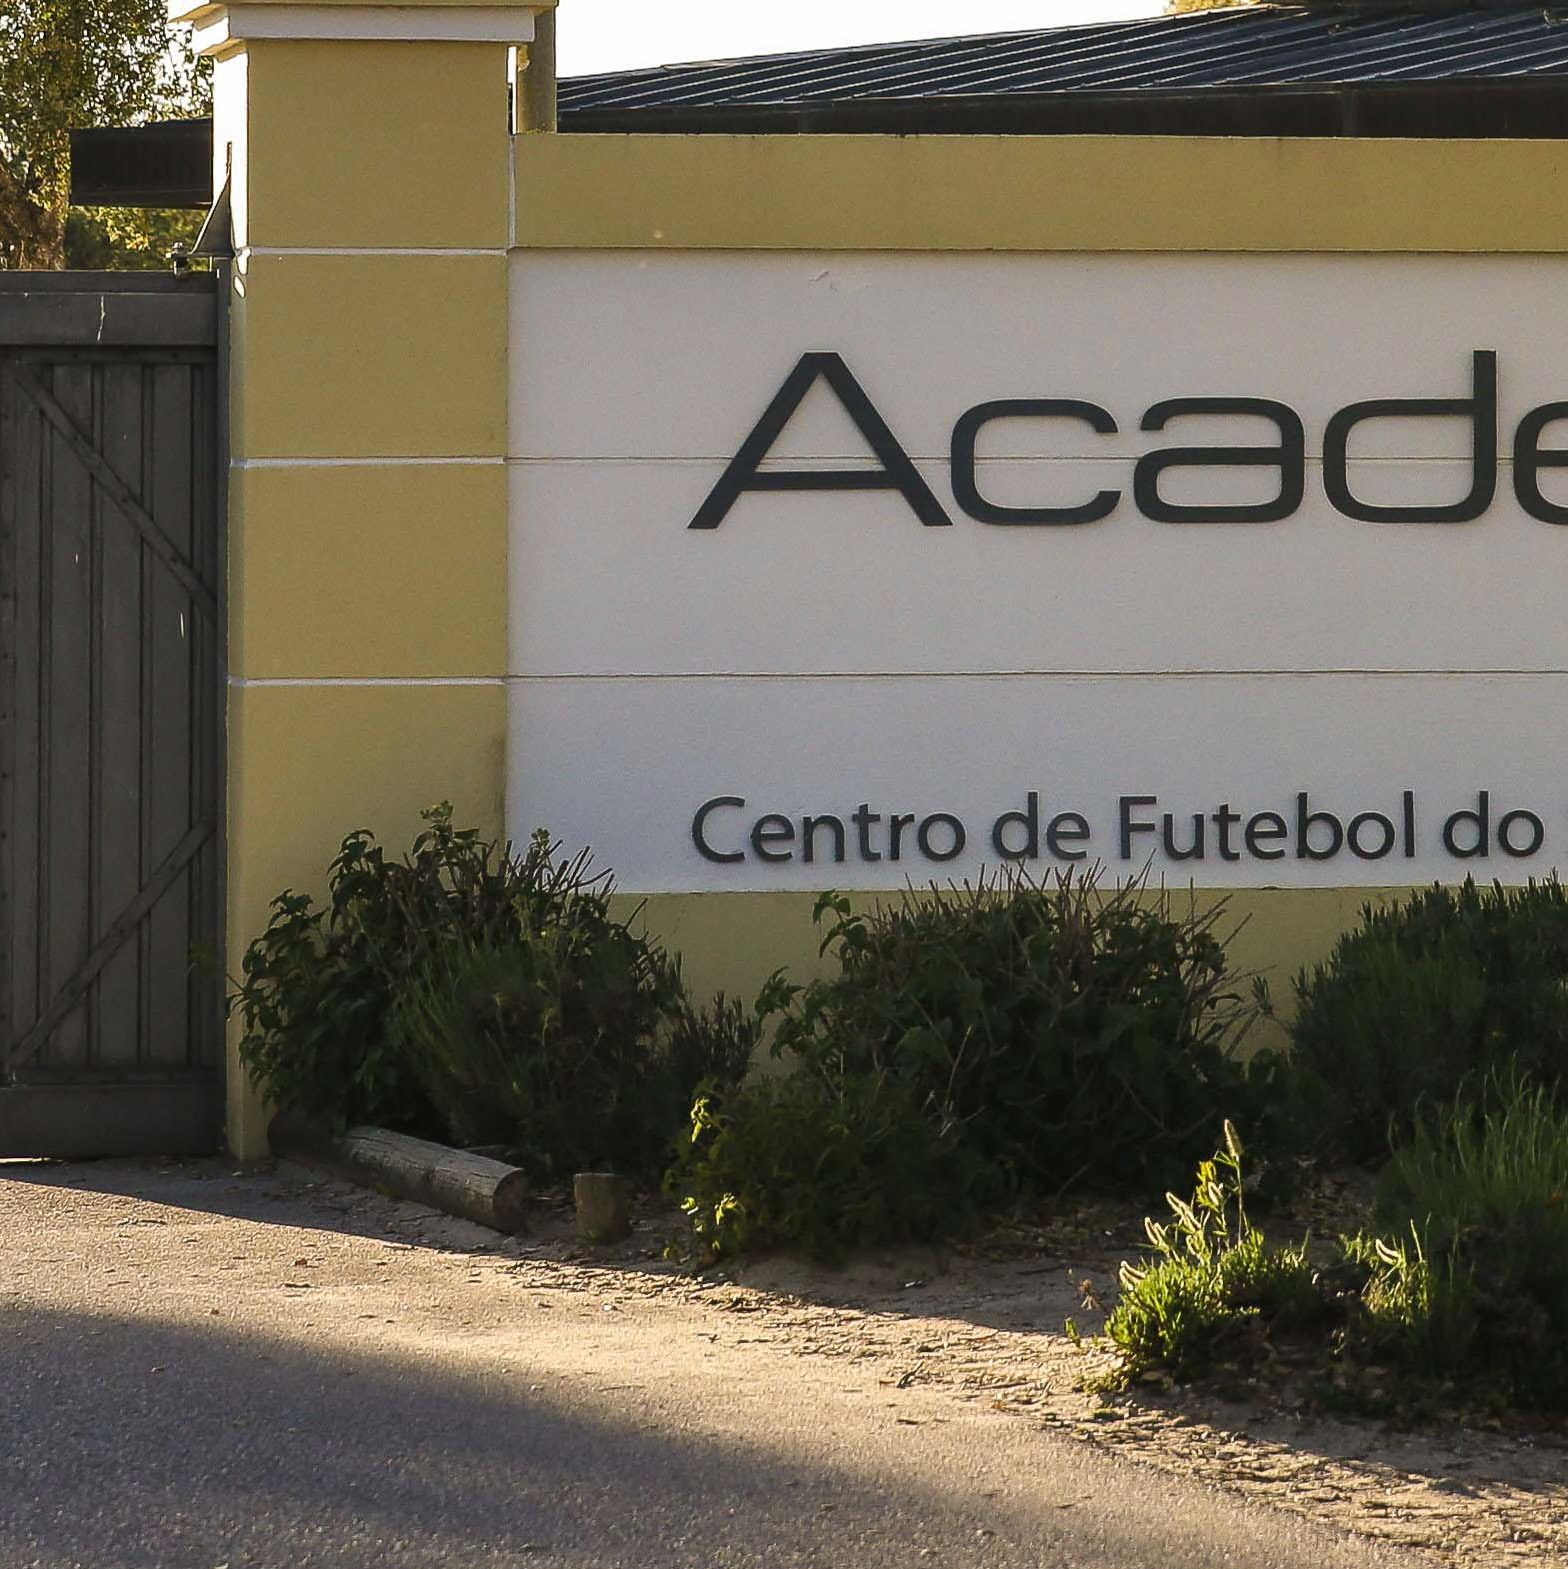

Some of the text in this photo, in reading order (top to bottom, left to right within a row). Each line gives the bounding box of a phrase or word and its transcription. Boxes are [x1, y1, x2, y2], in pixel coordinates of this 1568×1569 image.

[692, 795, 966, 866] Centro
[991, 791, 1091, 862] de
[1119, 790, 1416, 863] Futebol
[1442, 790, 1545, 861] do
